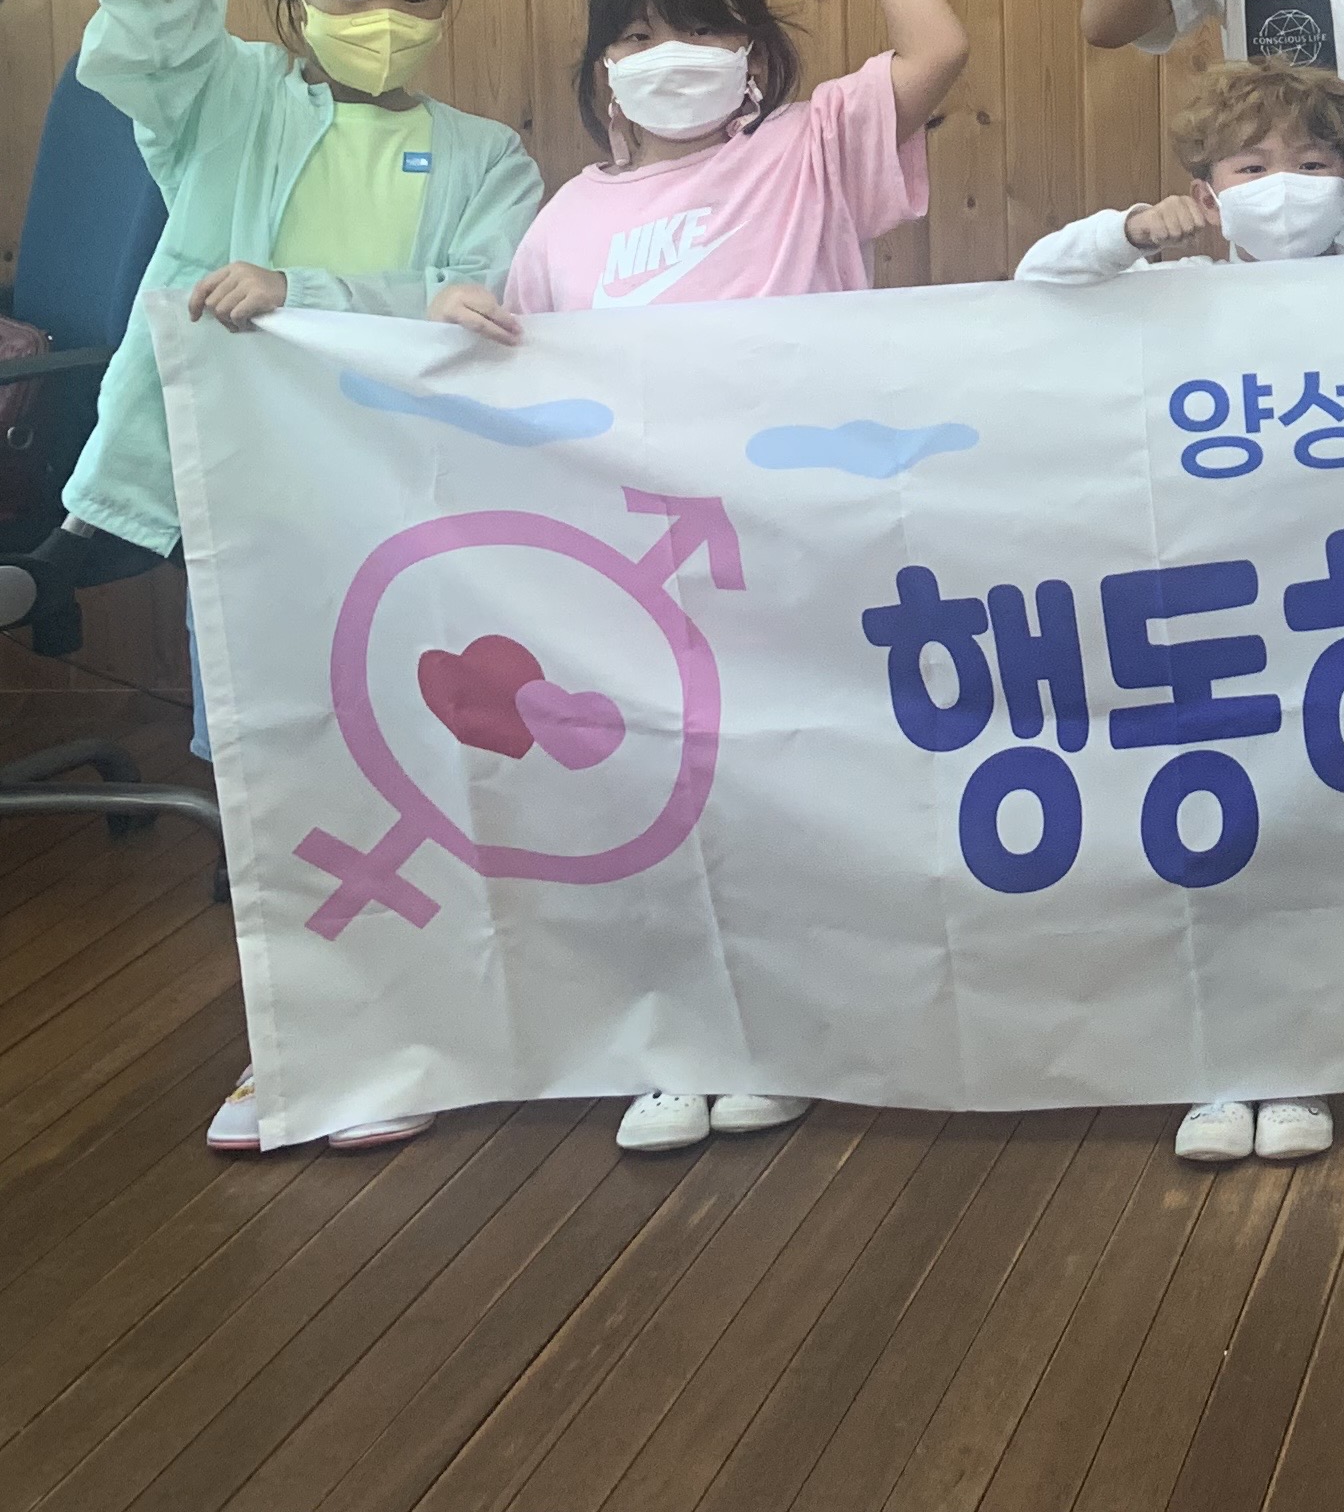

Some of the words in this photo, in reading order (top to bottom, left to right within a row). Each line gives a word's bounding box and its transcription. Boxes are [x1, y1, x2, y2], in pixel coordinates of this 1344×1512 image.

[1252, 34, 1307, 45] CONSCIOUS
[1308, 33, 1327, 42] LIFE
[602, 206, 712, 286] NIKE
